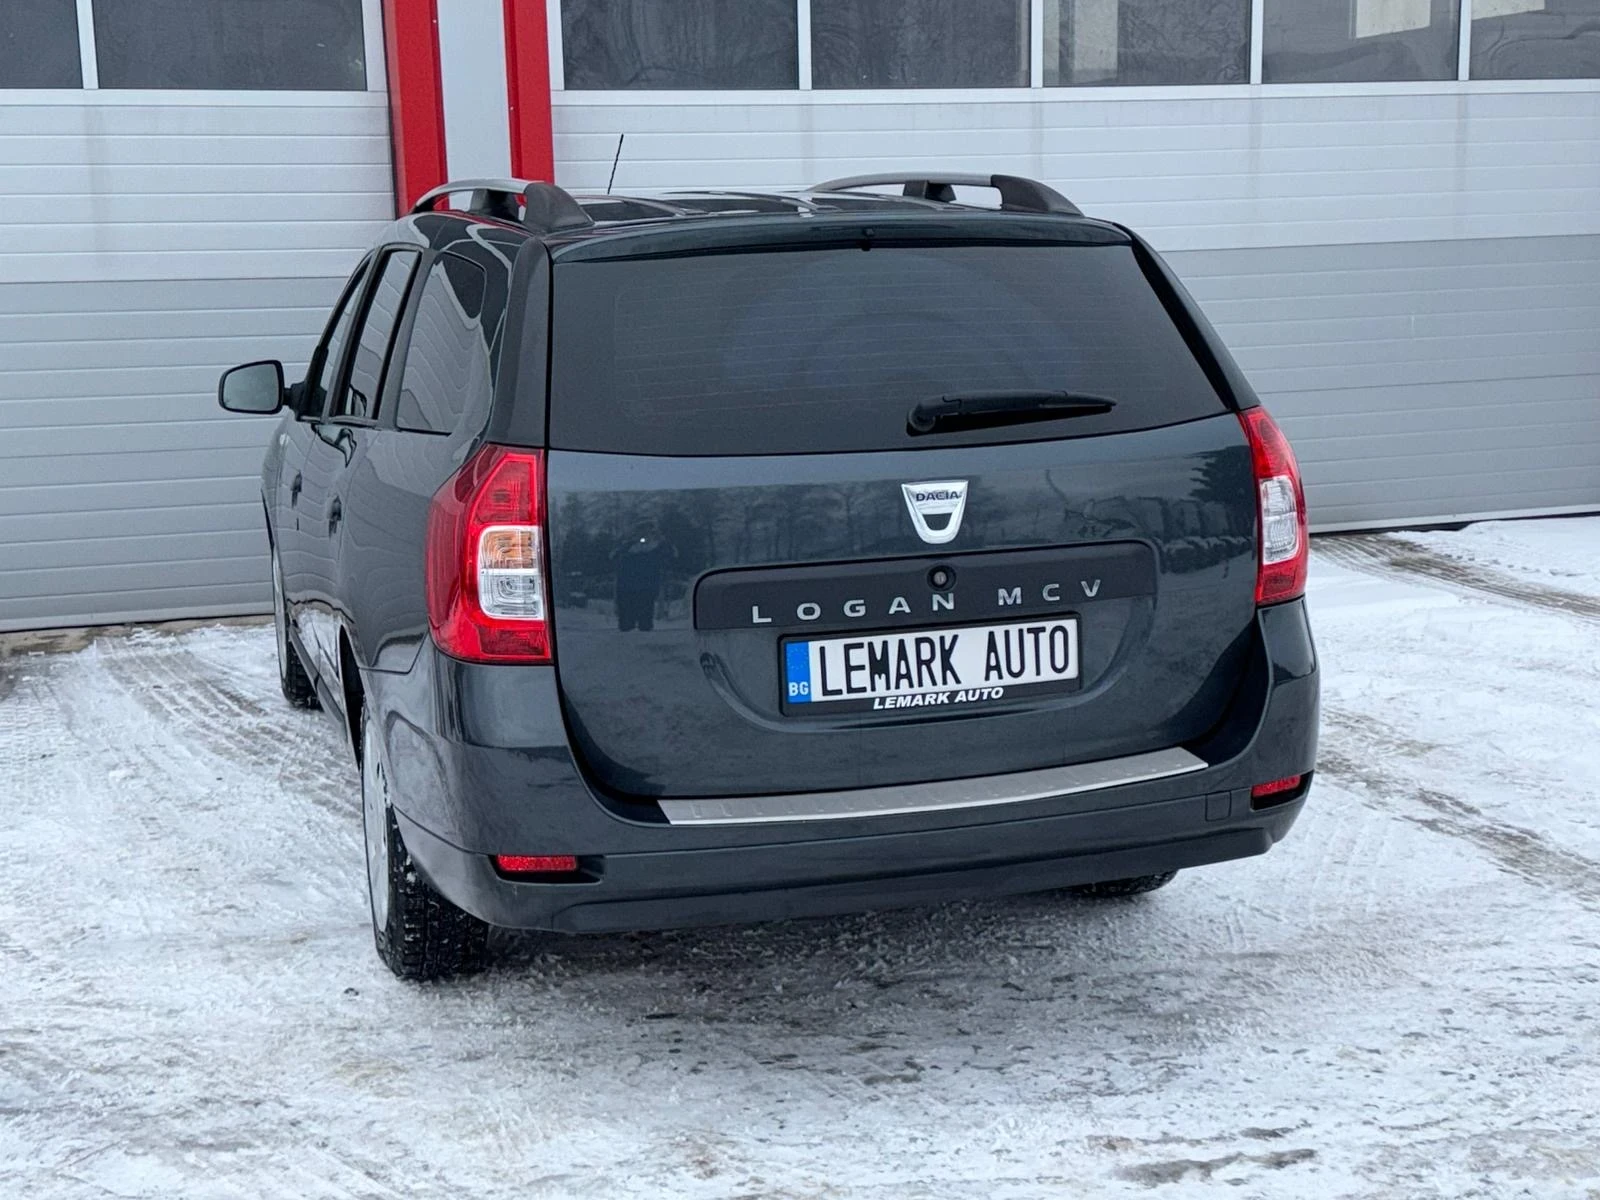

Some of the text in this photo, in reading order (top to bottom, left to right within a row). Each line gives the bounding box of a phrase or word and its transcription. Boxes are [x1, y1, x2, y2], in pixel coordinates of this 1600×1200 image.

[915, 490, 959, 502] DACIA
[752, 579, 1101, 624] LOGAN MCV
[819, 625, 1070, 697] LEMARK AUTO
[788, 681, 809, 697] BG
[873, 687, 1004, 710] LEMARK AUTO
